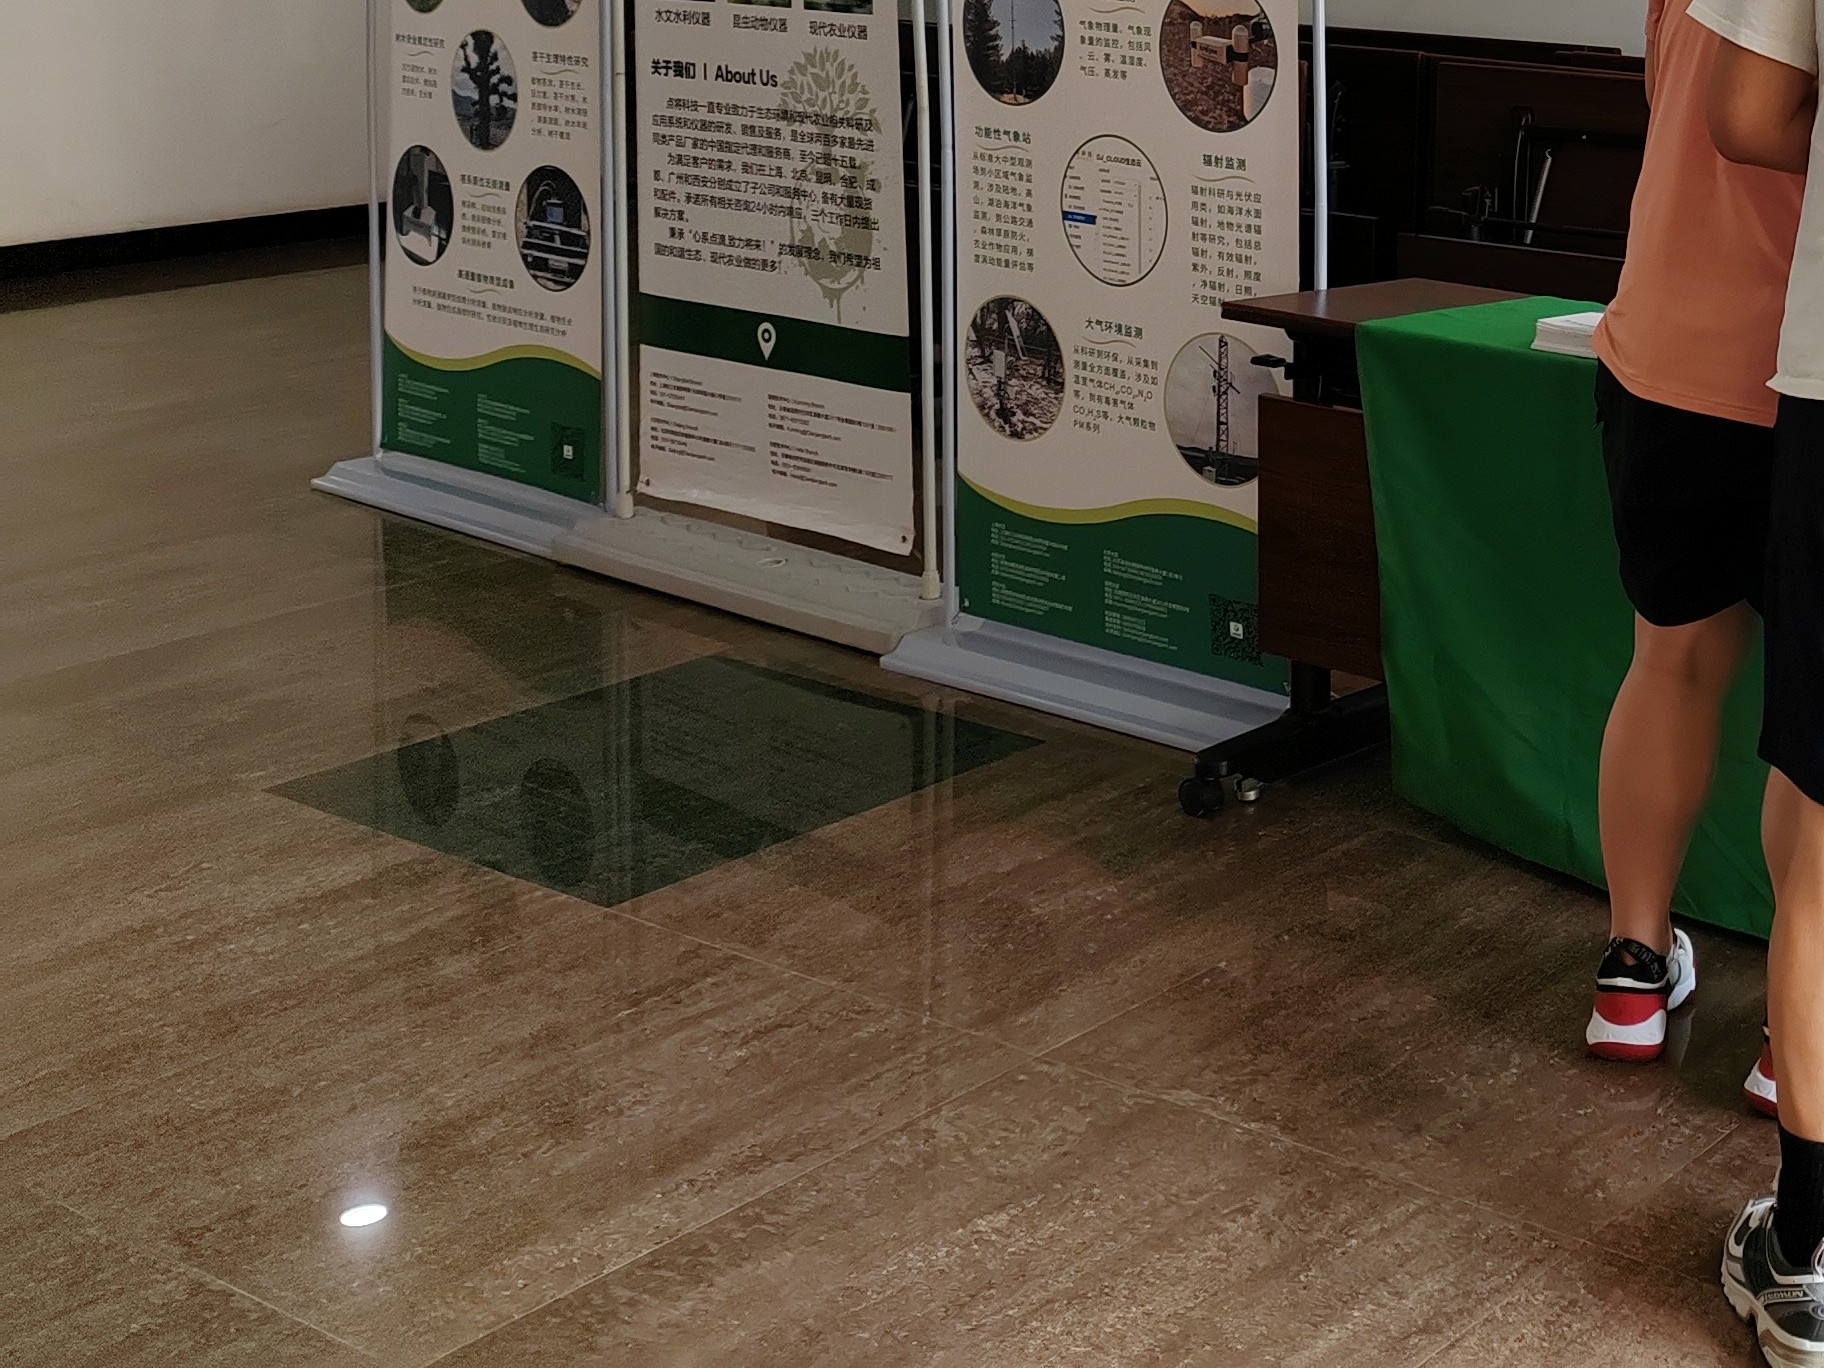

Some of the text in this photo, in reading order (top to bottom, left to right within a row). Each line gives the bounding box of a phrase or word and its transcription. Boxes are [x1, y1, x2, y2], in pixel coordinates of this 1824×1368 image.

[651, 58, 778, 87] 关于我们 About Us
[1202, 153, 1247, 171] 辐射监测
[1085, 317, 1143, 340] 大气环境监测
